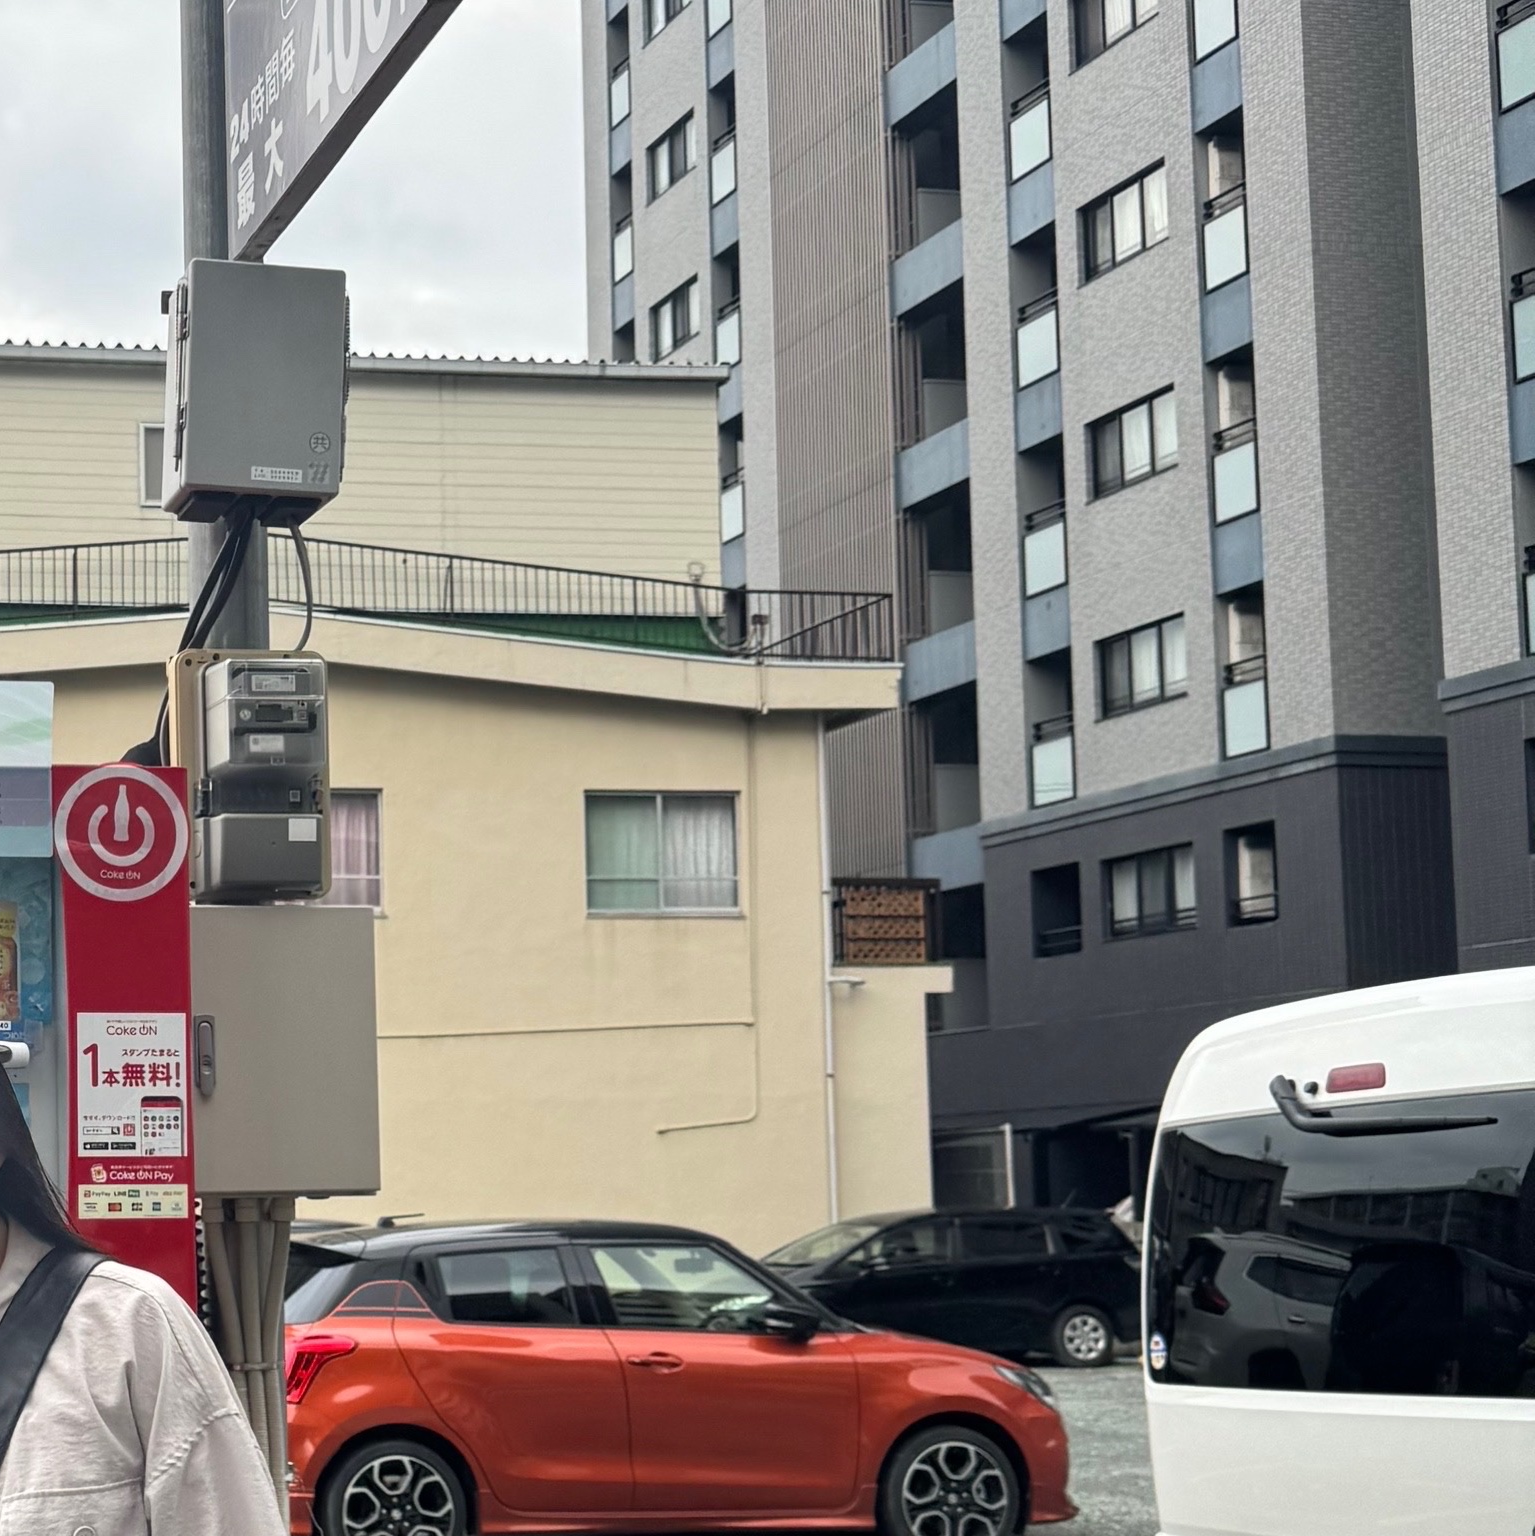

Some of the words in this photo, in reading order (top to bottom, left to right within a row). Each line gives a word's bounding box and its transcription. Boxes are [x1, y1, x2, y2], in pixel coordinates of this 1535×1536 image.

[229, 28, 295, 163] 24時間毎
[237, 117, 284, 230] 最大
[100, 869, 125, 880] Coke
[126, 870, 141, 880] ON
[106, 1025, 137, 1036] Coke
[138, 1024, 158, 1036] ON
[121, 1048, 180, 1057] スタンプたまると
[83, 1043, 181, 1088] 1本無料!
[109, 1170, 135, 1180] Coke
[136, 1169, 153, 1180] ON
[154, 1170, 174, 1182] Pay
